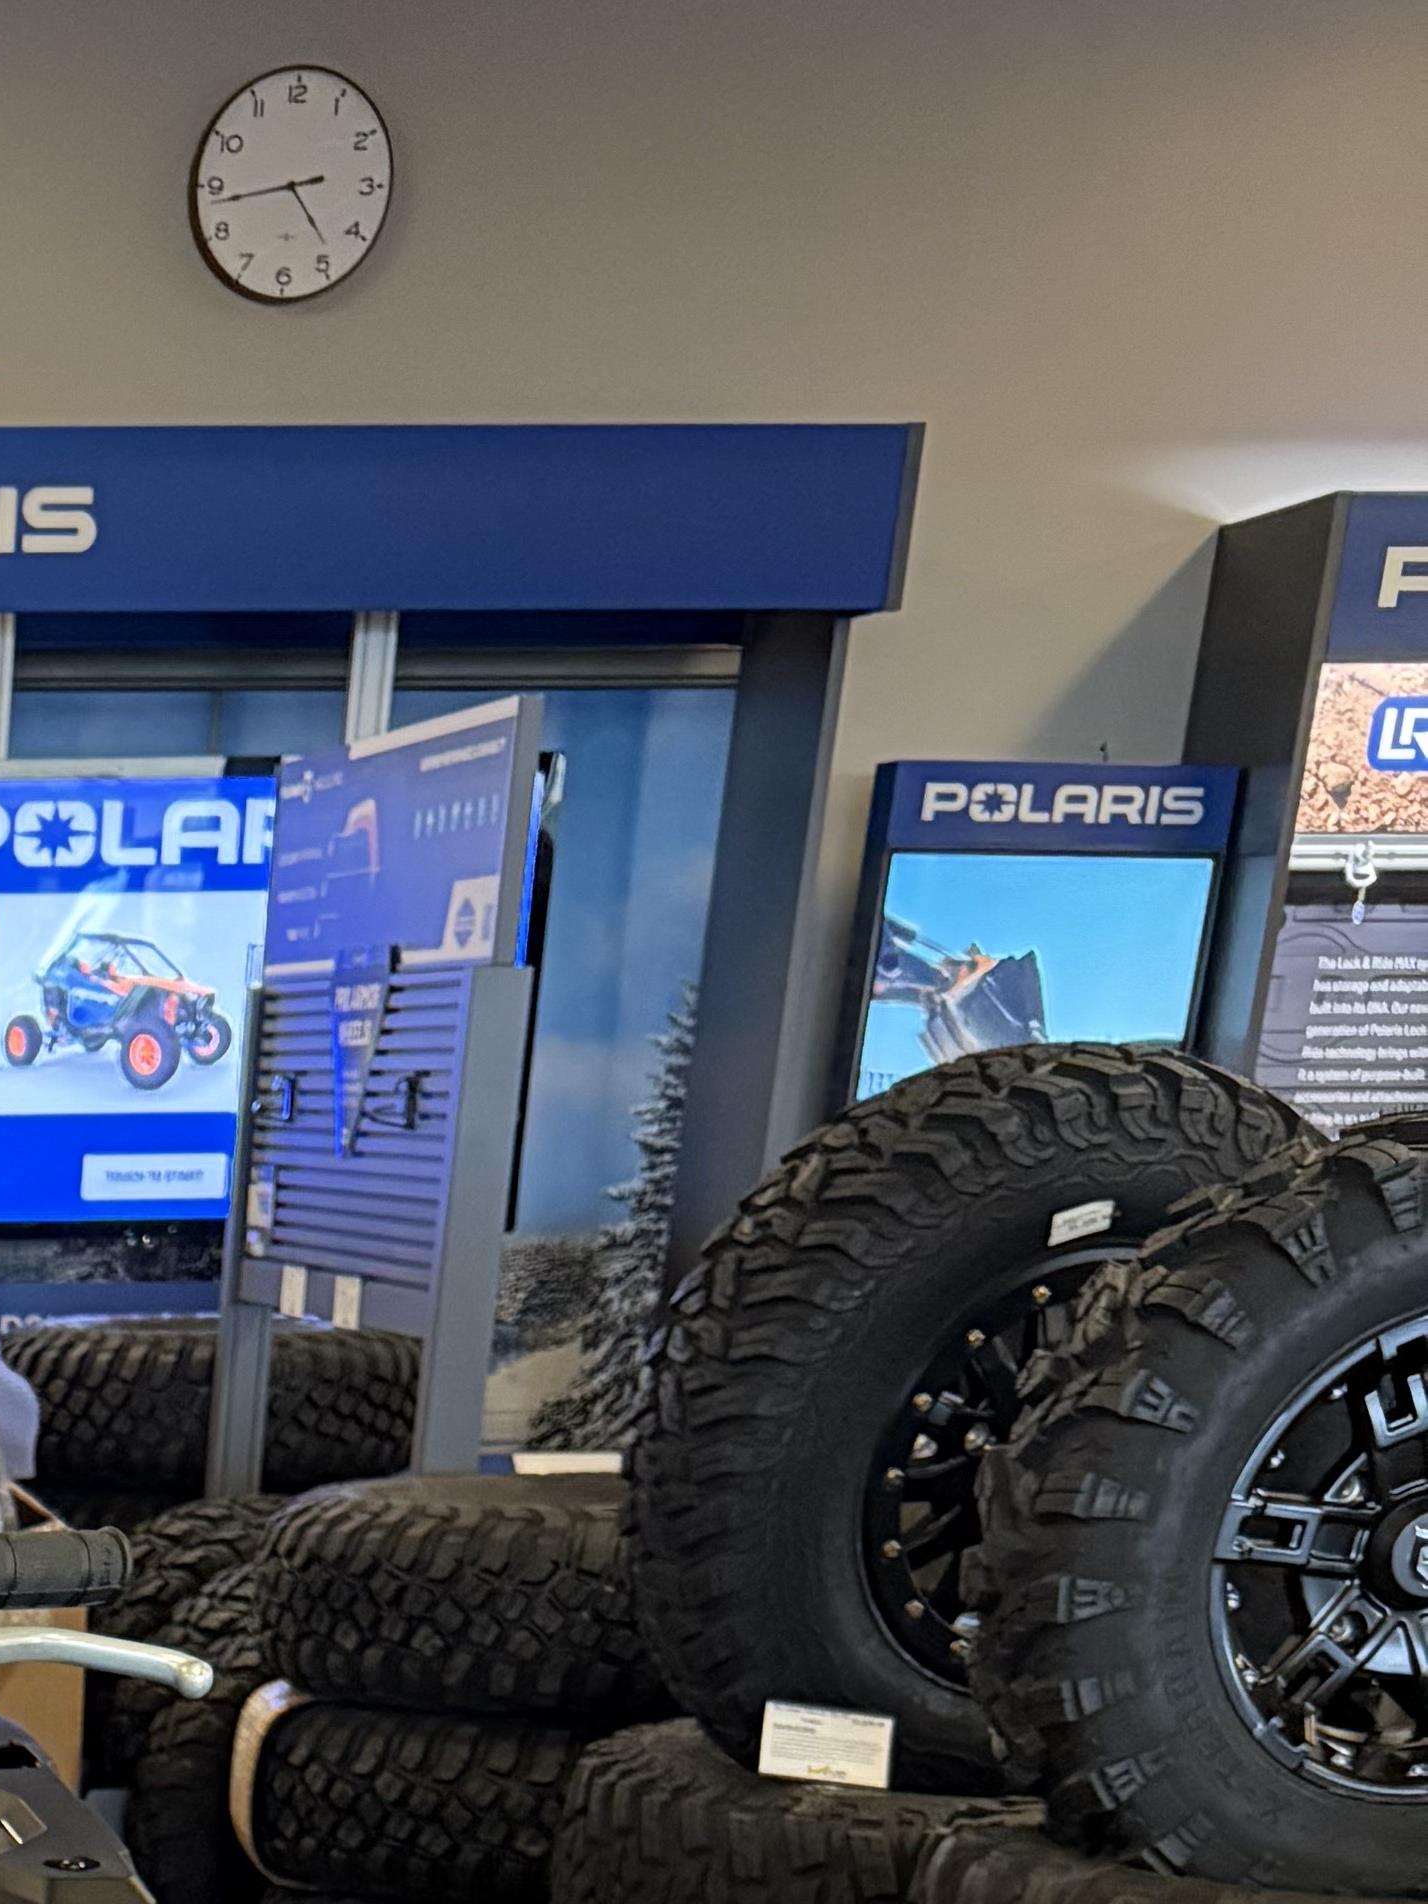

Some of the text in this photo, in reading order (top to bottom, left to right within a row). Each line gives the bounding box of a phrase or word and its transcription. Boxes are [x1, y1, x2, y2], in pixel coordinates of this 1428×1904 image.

[288, 84, 308, 104] 12
[252, 98, 265, 118] 11
[333, 96, 340, 117] 1
[219, 133, 244, 154] 10
[352, 131, 369, 151] 2
[206, 176, 225, 196] 9
[359, 177, 375, 196] 3
[214, 222, 230, 241] 8
[344, 221, 361, 237] 4
[238, 252, 254, 271] 7
[314, 254, 330, 274] 5
[275, 266, 292, 286] 6
[920, 781, 1205, 826] POLARIS
